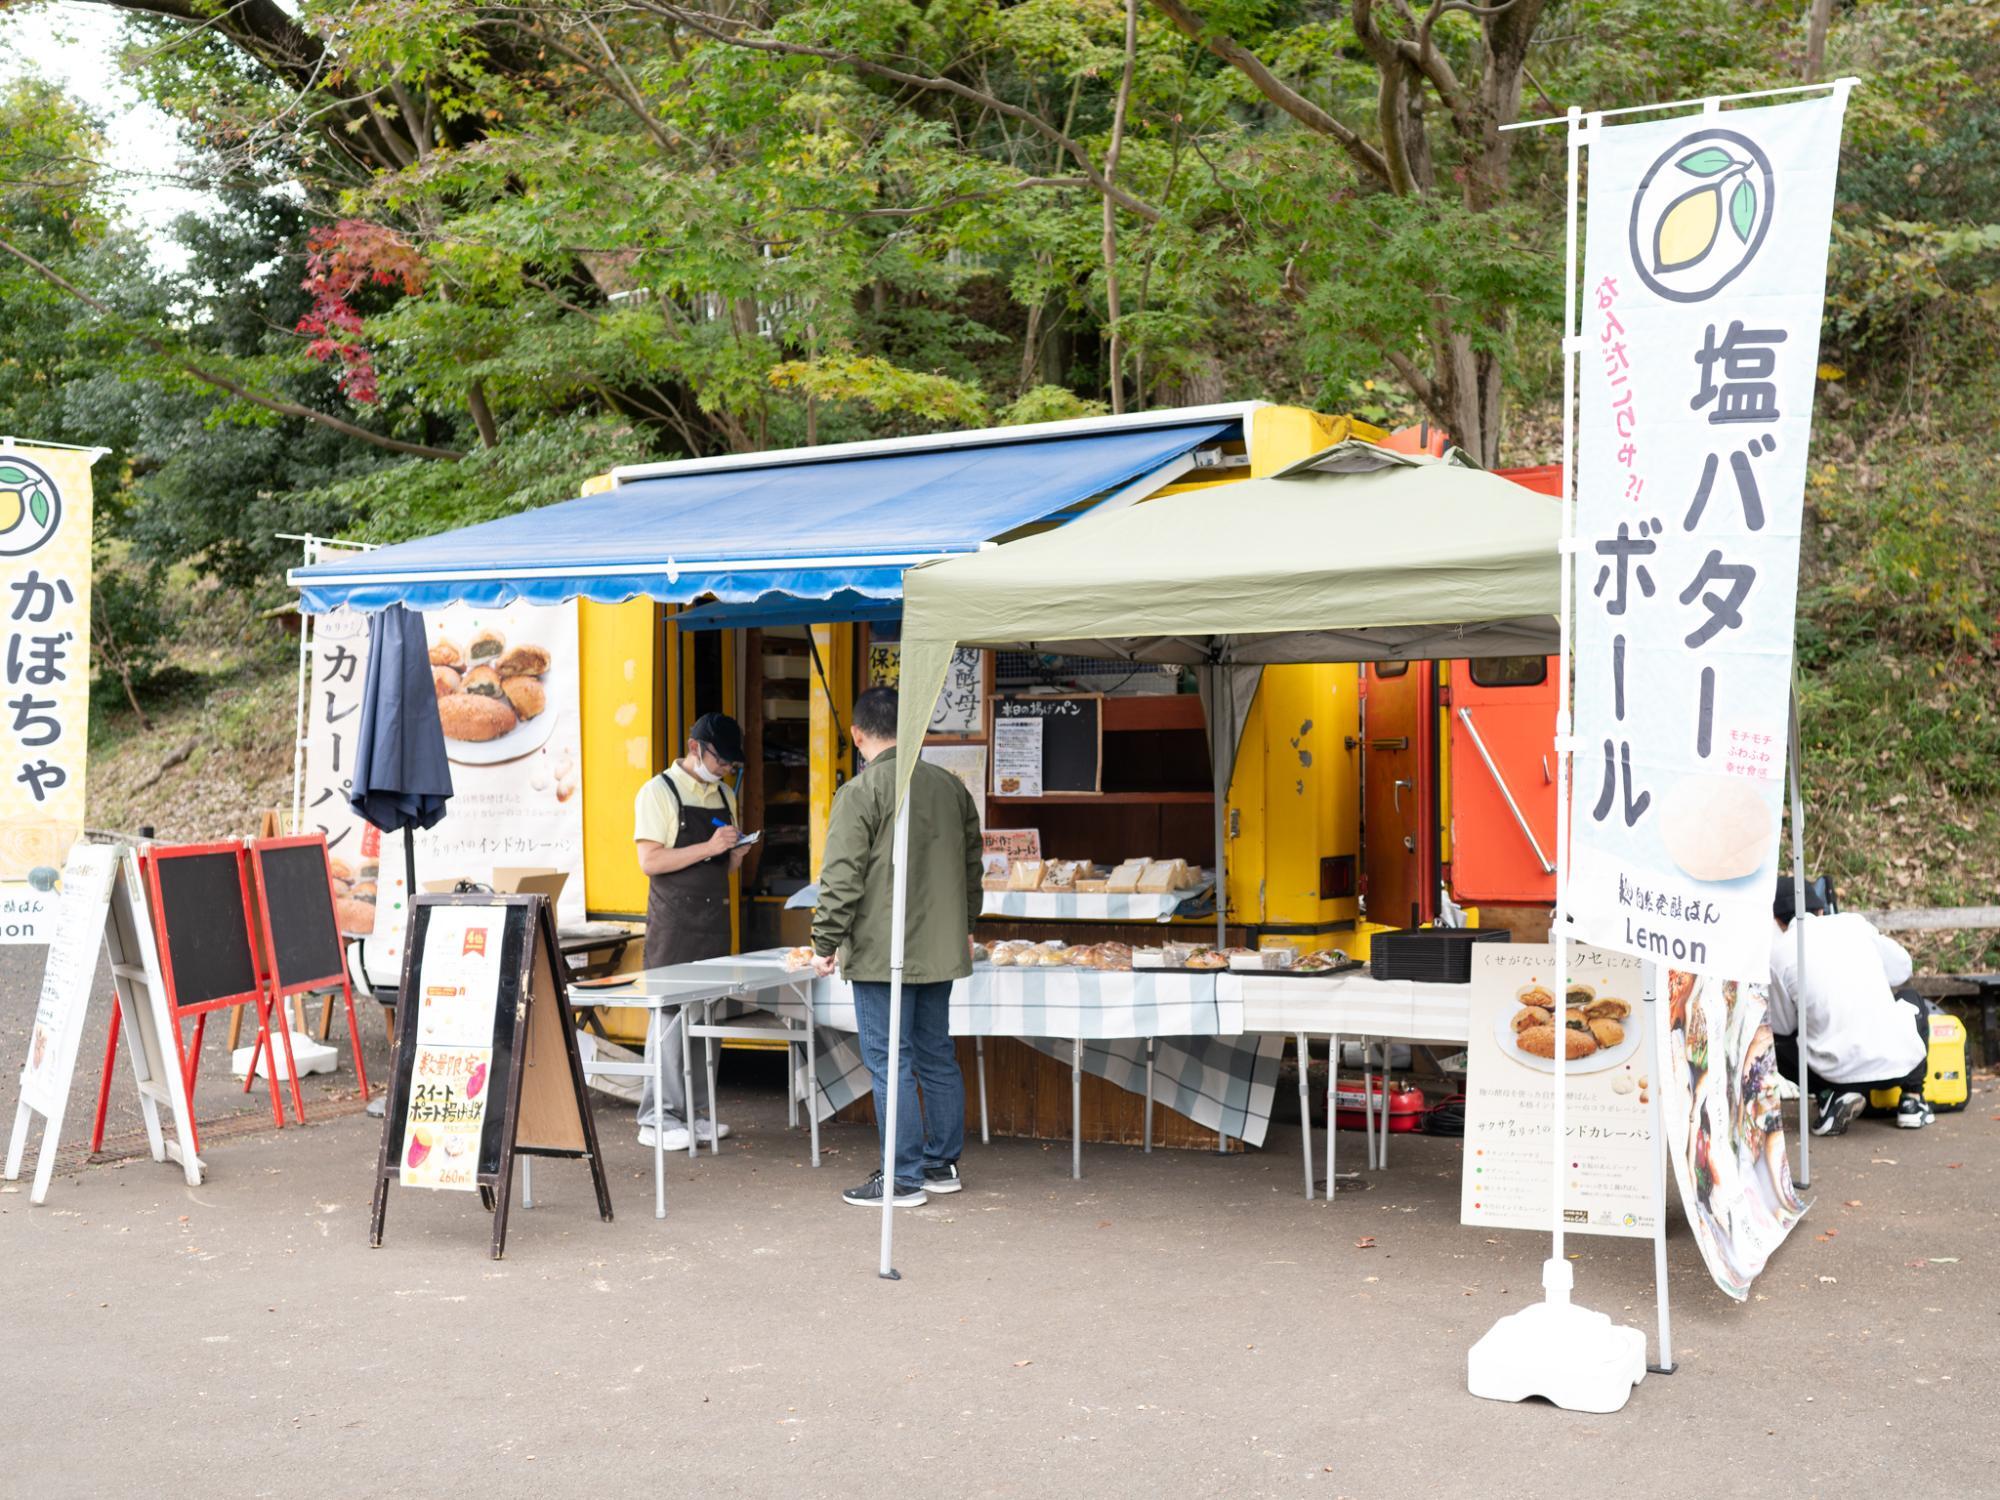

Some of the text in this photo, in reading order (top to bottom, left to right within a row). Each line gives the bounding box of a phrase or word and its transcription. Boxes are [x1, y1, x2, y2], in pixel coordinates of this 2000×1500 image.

[1679, 319, 1788, 759] 塩バター
[6, 570, 74, 802] かぼちゃ
[1593, 516, 1663, 827] ボール
[0, 924, 34, 937] on
[1626, 917, 1707, 965] Lemon
[415, 1084, 454, 1101] スイート
